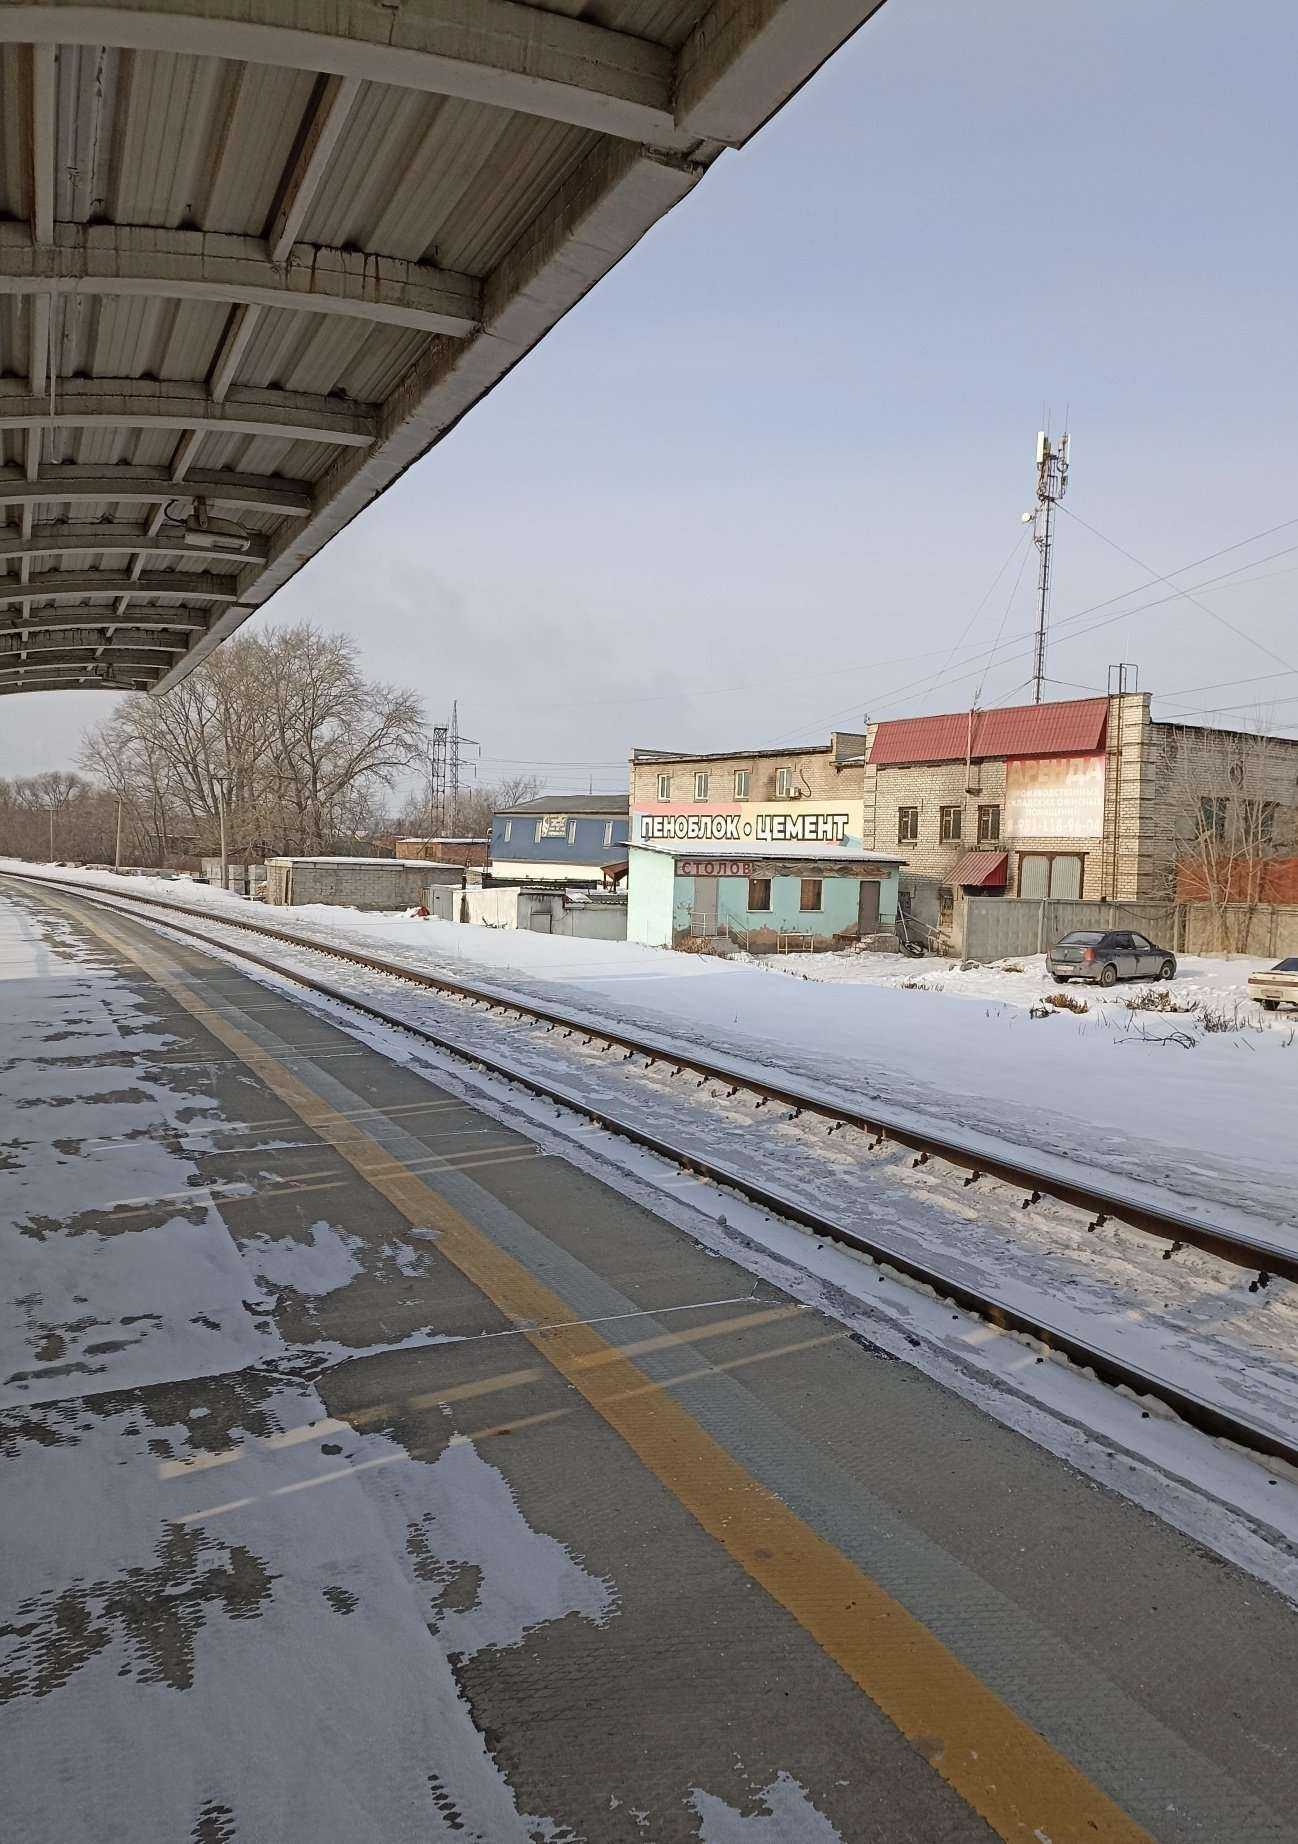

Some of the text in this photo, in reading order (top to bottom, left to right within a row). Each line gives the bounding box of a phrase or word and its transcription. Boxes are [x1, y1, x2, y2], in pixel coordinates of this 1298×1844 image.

[1010, 758, 1103, 785] АРЕНДА
[641, 814, 849, 841] ПЕНОБЛОК ЦЕМЕНТ
[682, 862, 751, 874] СТОЛОВ
